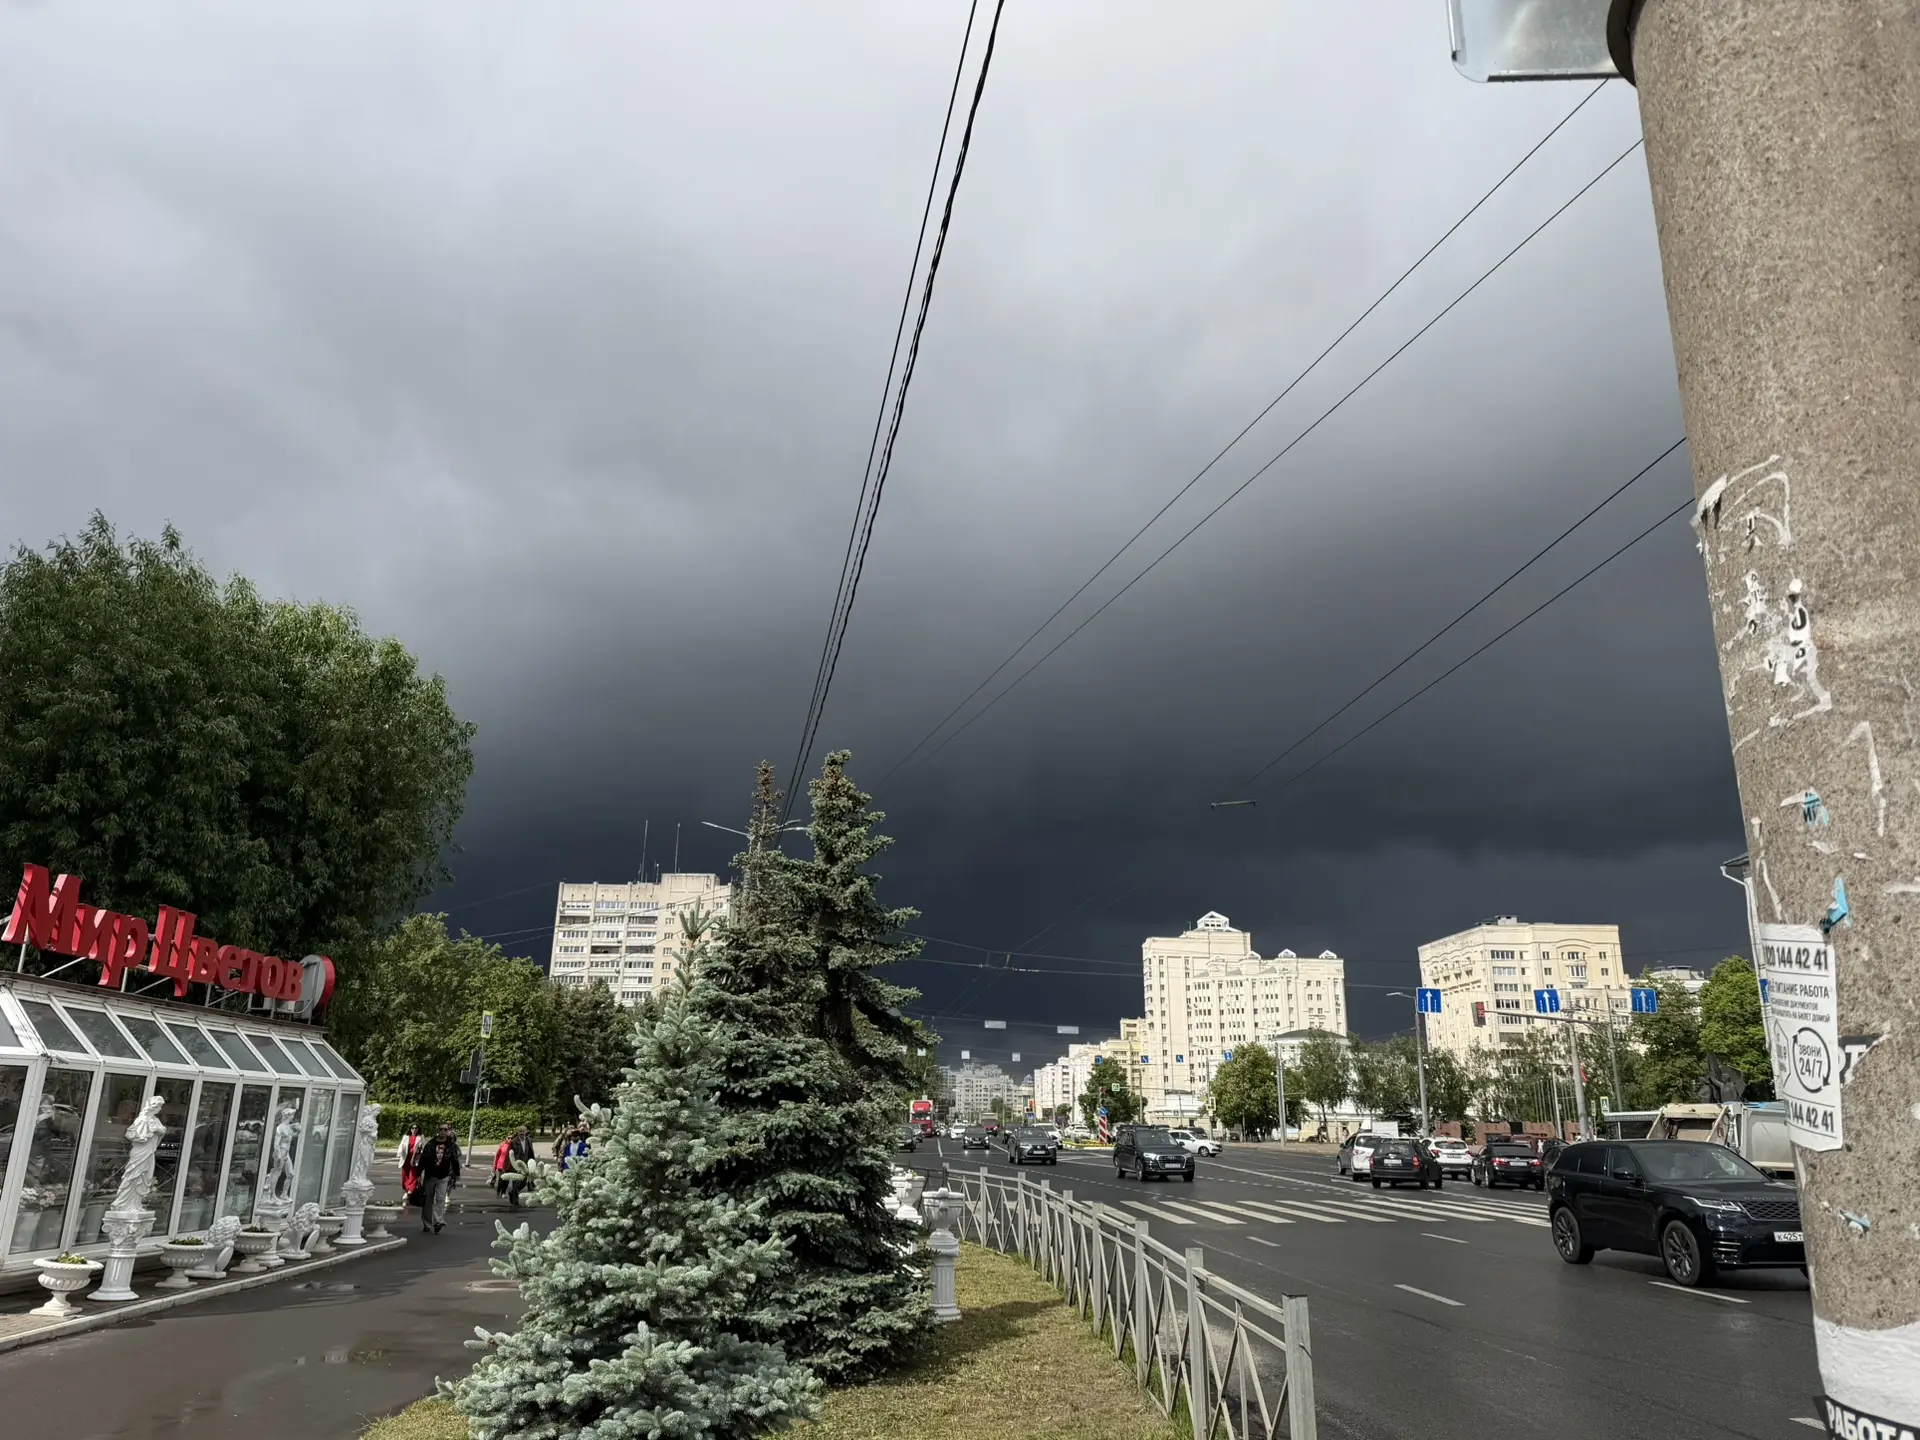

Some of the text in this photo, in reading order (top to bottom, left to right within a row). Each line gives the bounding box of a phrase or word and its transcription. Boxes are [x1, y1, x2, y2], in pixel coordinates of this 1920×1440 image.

[2, 862, 304, 1001] Мир Цветов
[1776, 946, 1793, 969] 144
[1795, 947, 1811, 969] 42
[1813, 947, 1828, 970] 41
[1799, 984, 1830, 999] РАБОТА
[1798, 1044, 1822, 1058] ЗВОНИ
[1799, 1057, 1823, 1078] 24/7
[1790, 1101, 1804, 1125] 144
[1805, 1105, 1819, 1129] 42
[1821, 1110, 1834, 1133] 41
